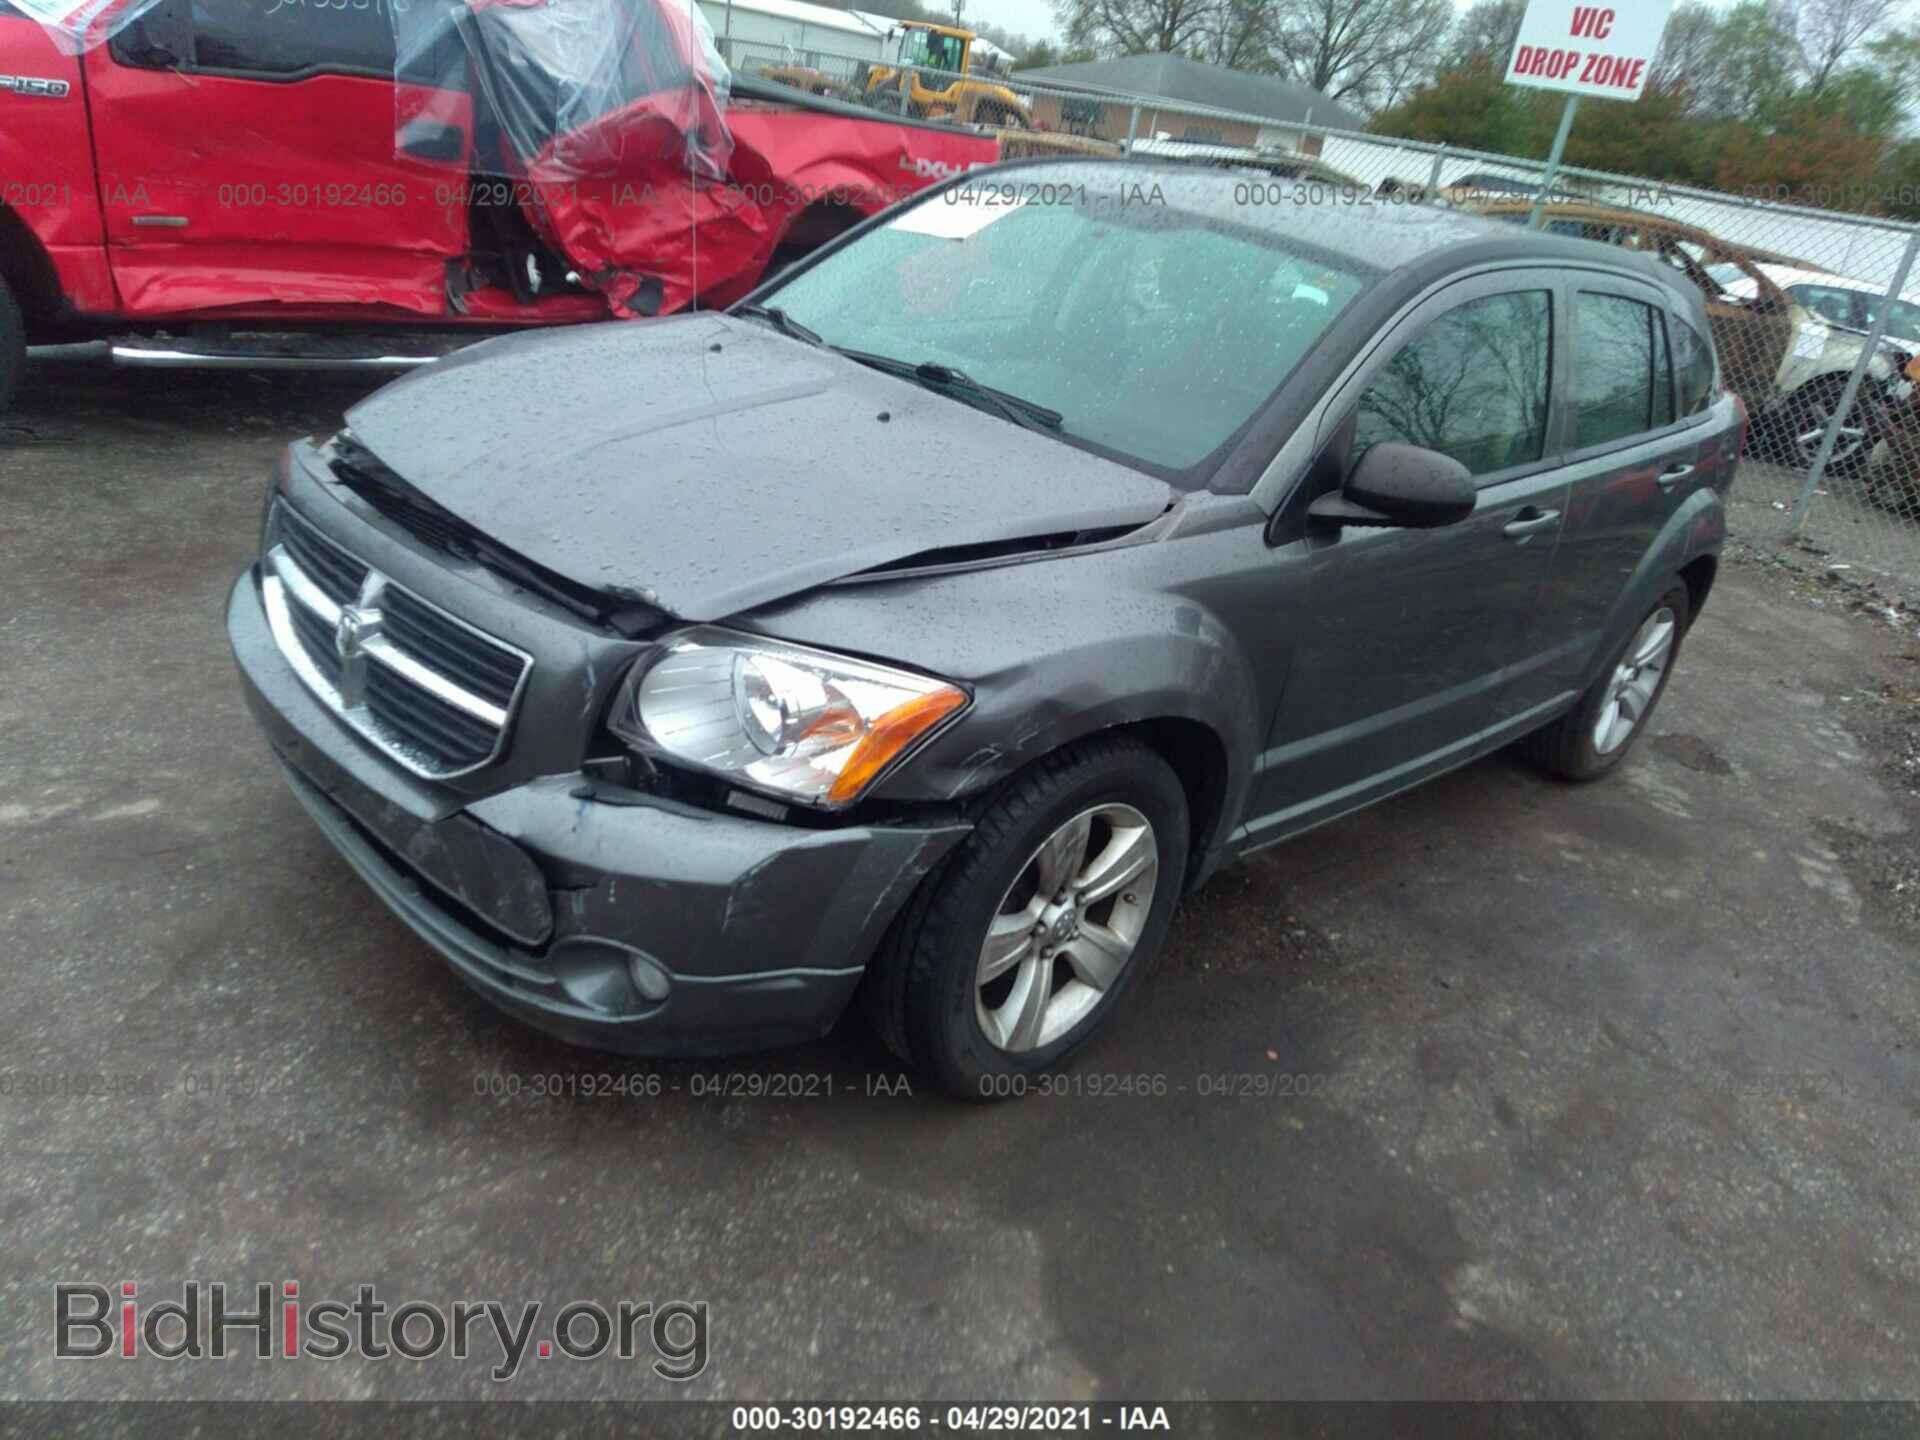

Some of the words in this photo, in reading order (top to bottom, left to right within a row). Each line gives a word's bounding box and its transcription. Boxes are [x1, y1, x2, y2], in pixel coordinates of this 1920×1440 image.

[1569, 6, 1616, 39] VIC
[1513, 45, 1580, 80] DROP
[1578, 53, 1647, 89] ZONE
